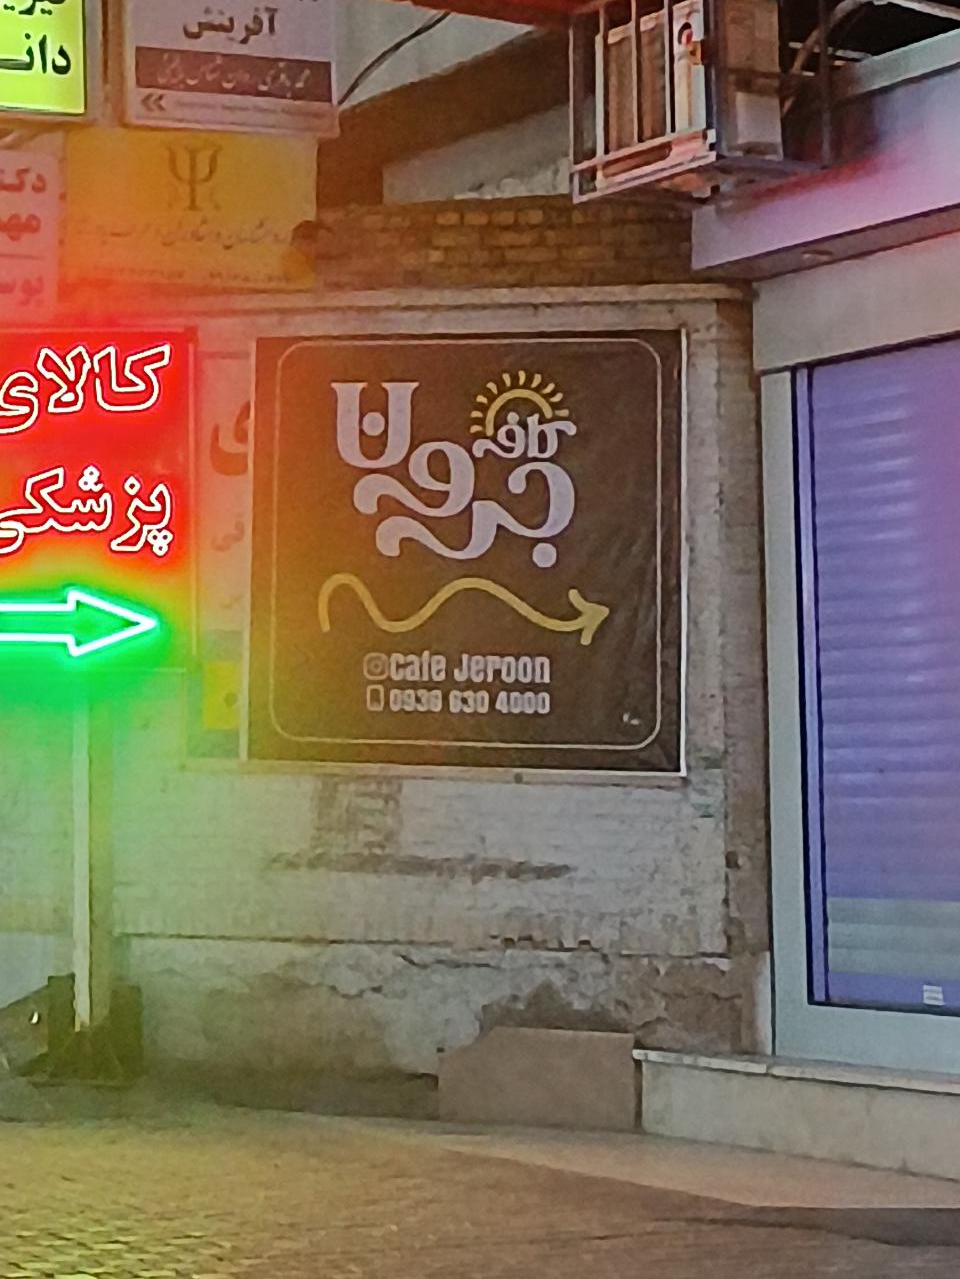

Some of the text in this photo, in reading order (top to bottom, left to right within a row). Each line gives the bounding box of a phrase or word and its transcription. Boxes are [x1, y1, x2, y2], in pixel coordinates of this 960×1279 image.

[183, 6, 279, 44] آفرینش
[453, 653, 551, 684] Jeroon
[495, 691, 551, 715] 4000
